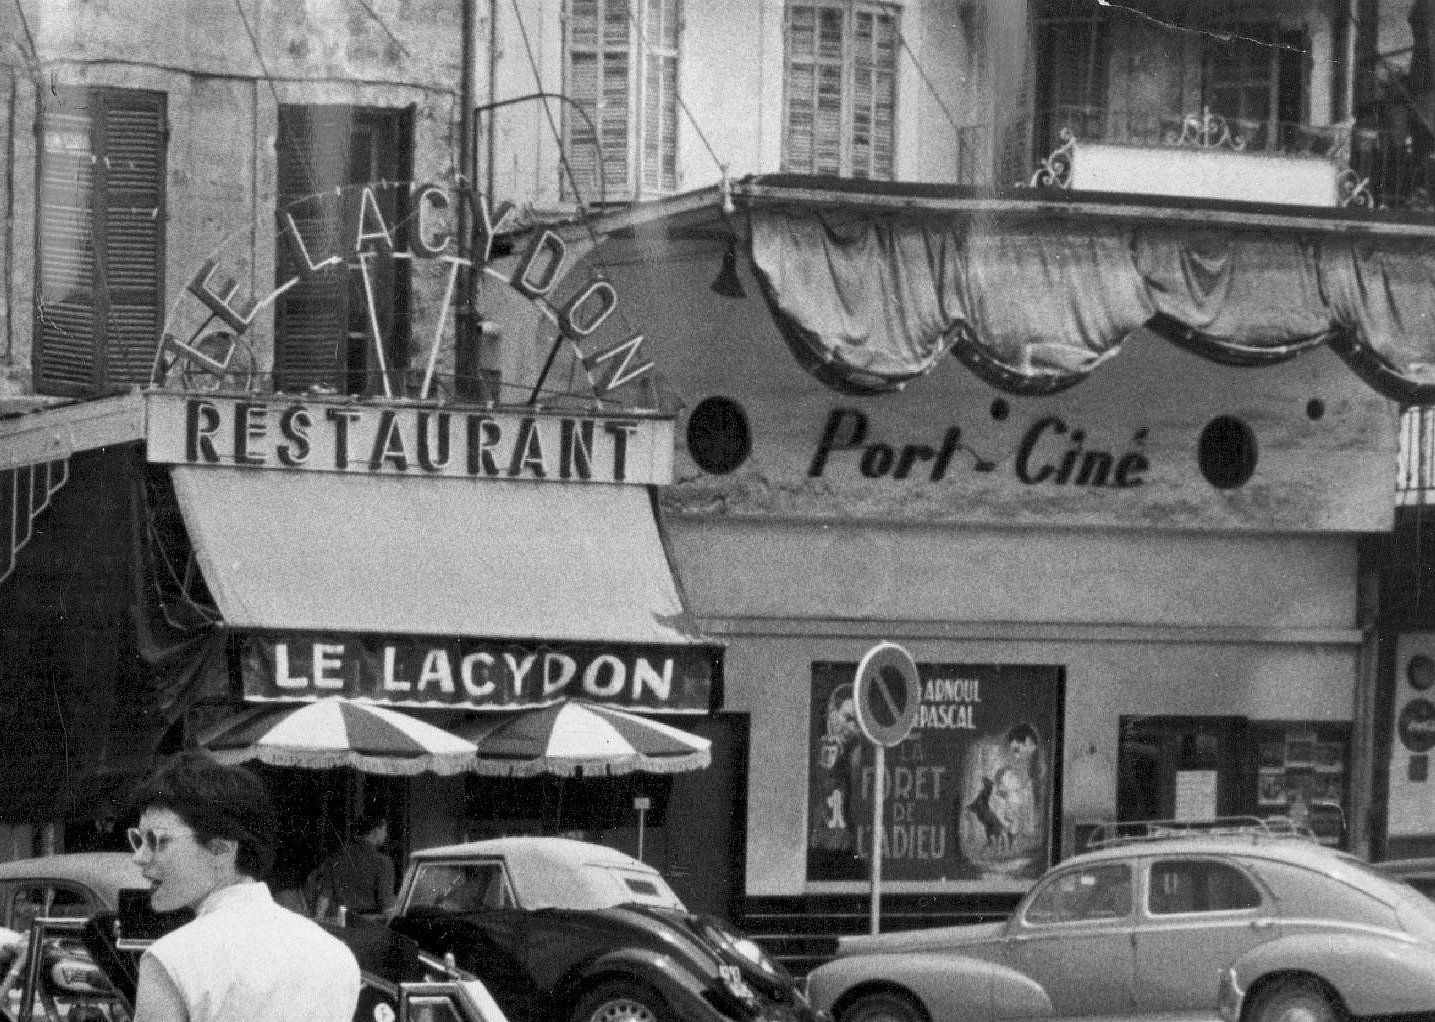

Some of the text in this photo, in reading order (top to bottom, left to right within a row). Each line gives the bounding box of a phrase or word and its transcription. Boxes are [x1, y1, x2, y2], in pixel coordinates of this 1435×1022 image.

[164, 183, 656, 398] LE LACYDON
[185, 401, 640, 482] RESTAURANT
[1017, 415, 1150, 488] Ciné
[273, 643, 675, 701] LE LACYDON
[919, 704, 977, 729] PASCAL
